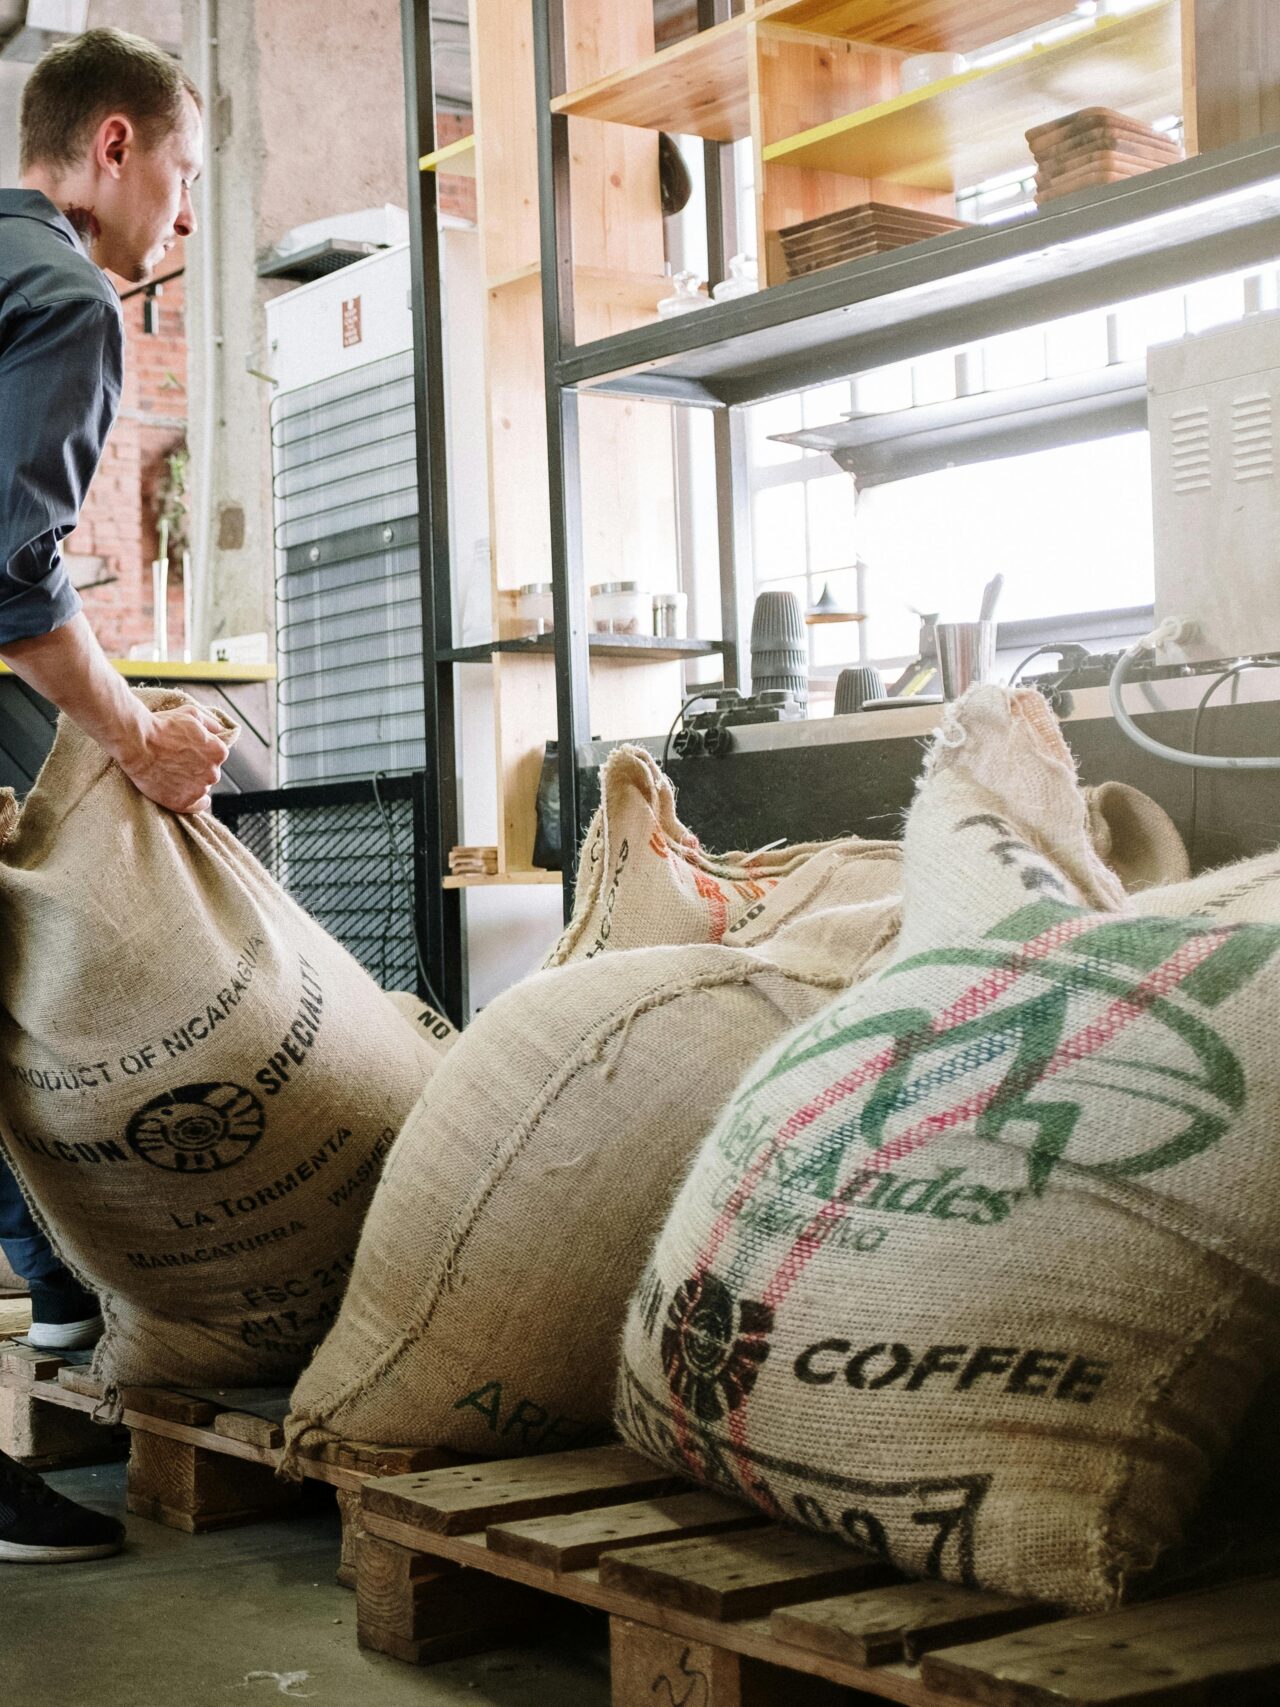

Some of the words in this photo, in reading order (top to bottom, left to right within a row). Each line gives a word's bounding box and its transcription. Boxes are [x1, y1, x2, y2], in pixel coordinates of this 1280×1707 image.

[120, 1044, 157, 1076] OF
[162, 931, 265, 1058] NICARAGUA
[255, 950, 324, 1096] SPECIALTY
[170, 1209, 214, 1230] LA
[217, 1126, 353, 1219] TORMENTA
[327, 1126, 396, 1208] WASHED
[792, 1337, 1111, 1403] COFFEE
